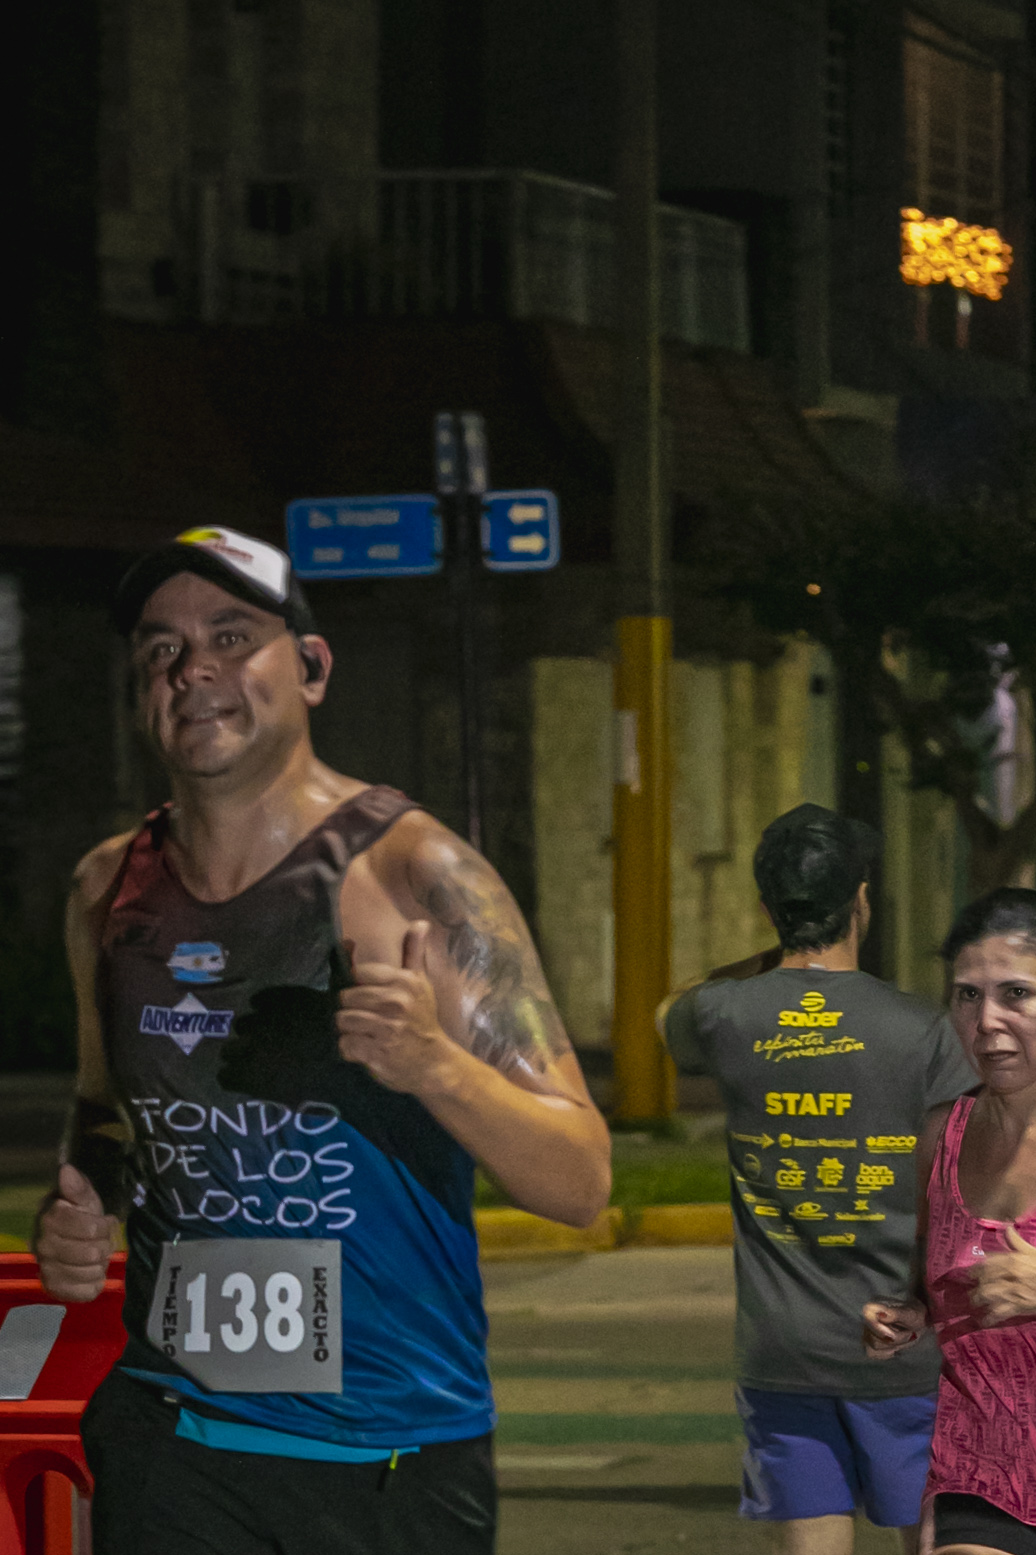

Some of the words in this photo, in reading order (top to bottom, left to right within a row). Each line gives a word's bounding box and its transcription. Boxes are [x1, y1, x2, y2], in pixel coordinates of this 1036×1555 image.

[131, 1097, 341, 1136] FONDO
[765, 1092, 852, 1115] STAFF
[148, 1143, 210, 1178] DE
[232, 1142, 354, 1183] LOS
[172, 1188, 357, 1230] LOCOS
[162, 1266, 182, 1359] TIEMPO
[184, 1271, 305, 1353] 138
[312, 1267, 329, 1362] EXACTO
